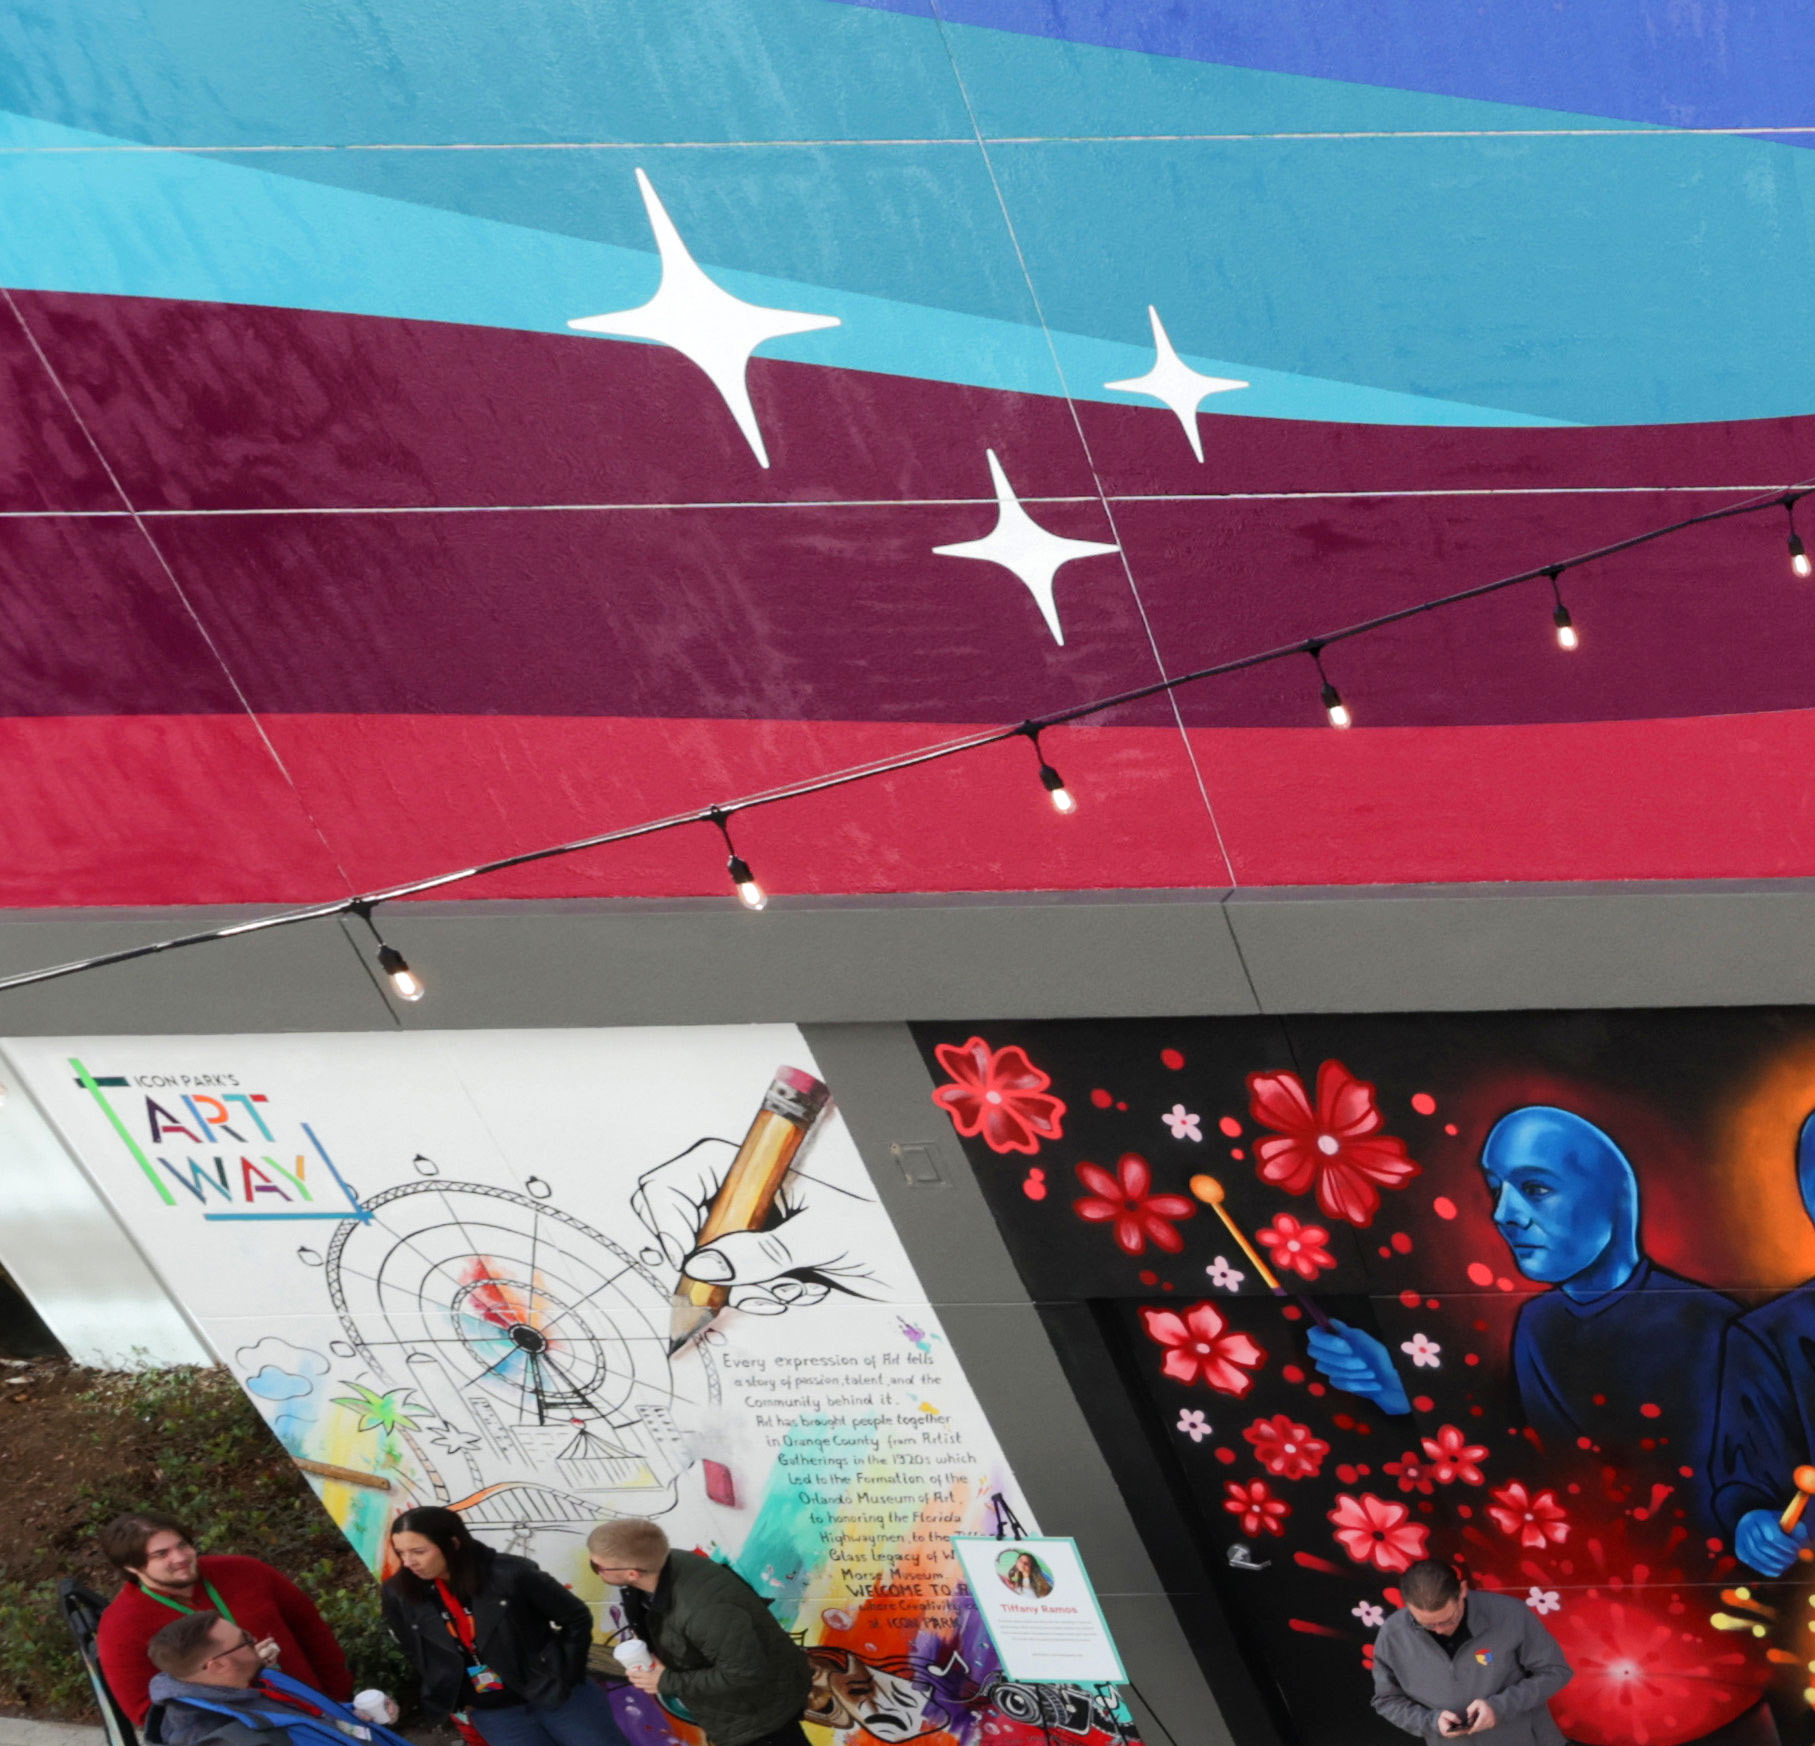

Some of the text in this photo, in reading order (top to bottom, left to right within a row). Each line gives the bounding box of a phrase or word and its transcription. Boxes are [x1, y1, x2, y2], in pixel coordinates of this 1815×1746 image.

[135, 1073, 240, 1088] ICON PARK'S
[145, 1094, 276, 1143] ART
[157, 1155, 314, 1205] WAY
[722, 1351, 934, 1370] Every expression of Art tells
[743, 1376, 776, 1391] story
[780, 1373, 792, 1389] of
[921, 1373, 942, 1385] the
[744, 1395, 821, 1412] Community
[826, 1393, 874, 1407] behind
[756, 1413, 952, 1431] Art has brought people together
[766, 1431, 963, 1451] in Orange County from Artist
[778, 1453, 849, 1470] Gatherings
[853, 1454, 865, 1466] in
[867, 1453, 887, 1465] the
[935, 1452, 977, 1466] which
[787, 1472, 969, 1487] Led to the Formation of the
[798, 1491, 853, 1505] Orlando
[857, 1492, 916, 1504] Museum
[918, 1492, 930, 1505] of
[809, 1512, 962, 1529] to honoring the Florida
[912, 1532, 926, 1543] to
[928, 1531, 951, 1543] the
[829, 1549, 868, 1562] Glass
[872, 1548, 921, 1567] Legacy
[926, 1549, 938, 1562] of
[841, 1568, 883, 1581] Morse
[846, 1583, 921, 1598] WELCOME
[930, 1583, 952, 1597] TO
[899, 1600, 962, 1616] Creativity
[1000, 1603, 1078, 1615] Tiffany Ramos
[888, 1618, 921, 1629] ICON
[924, 1617, 962, 1629] PARK
